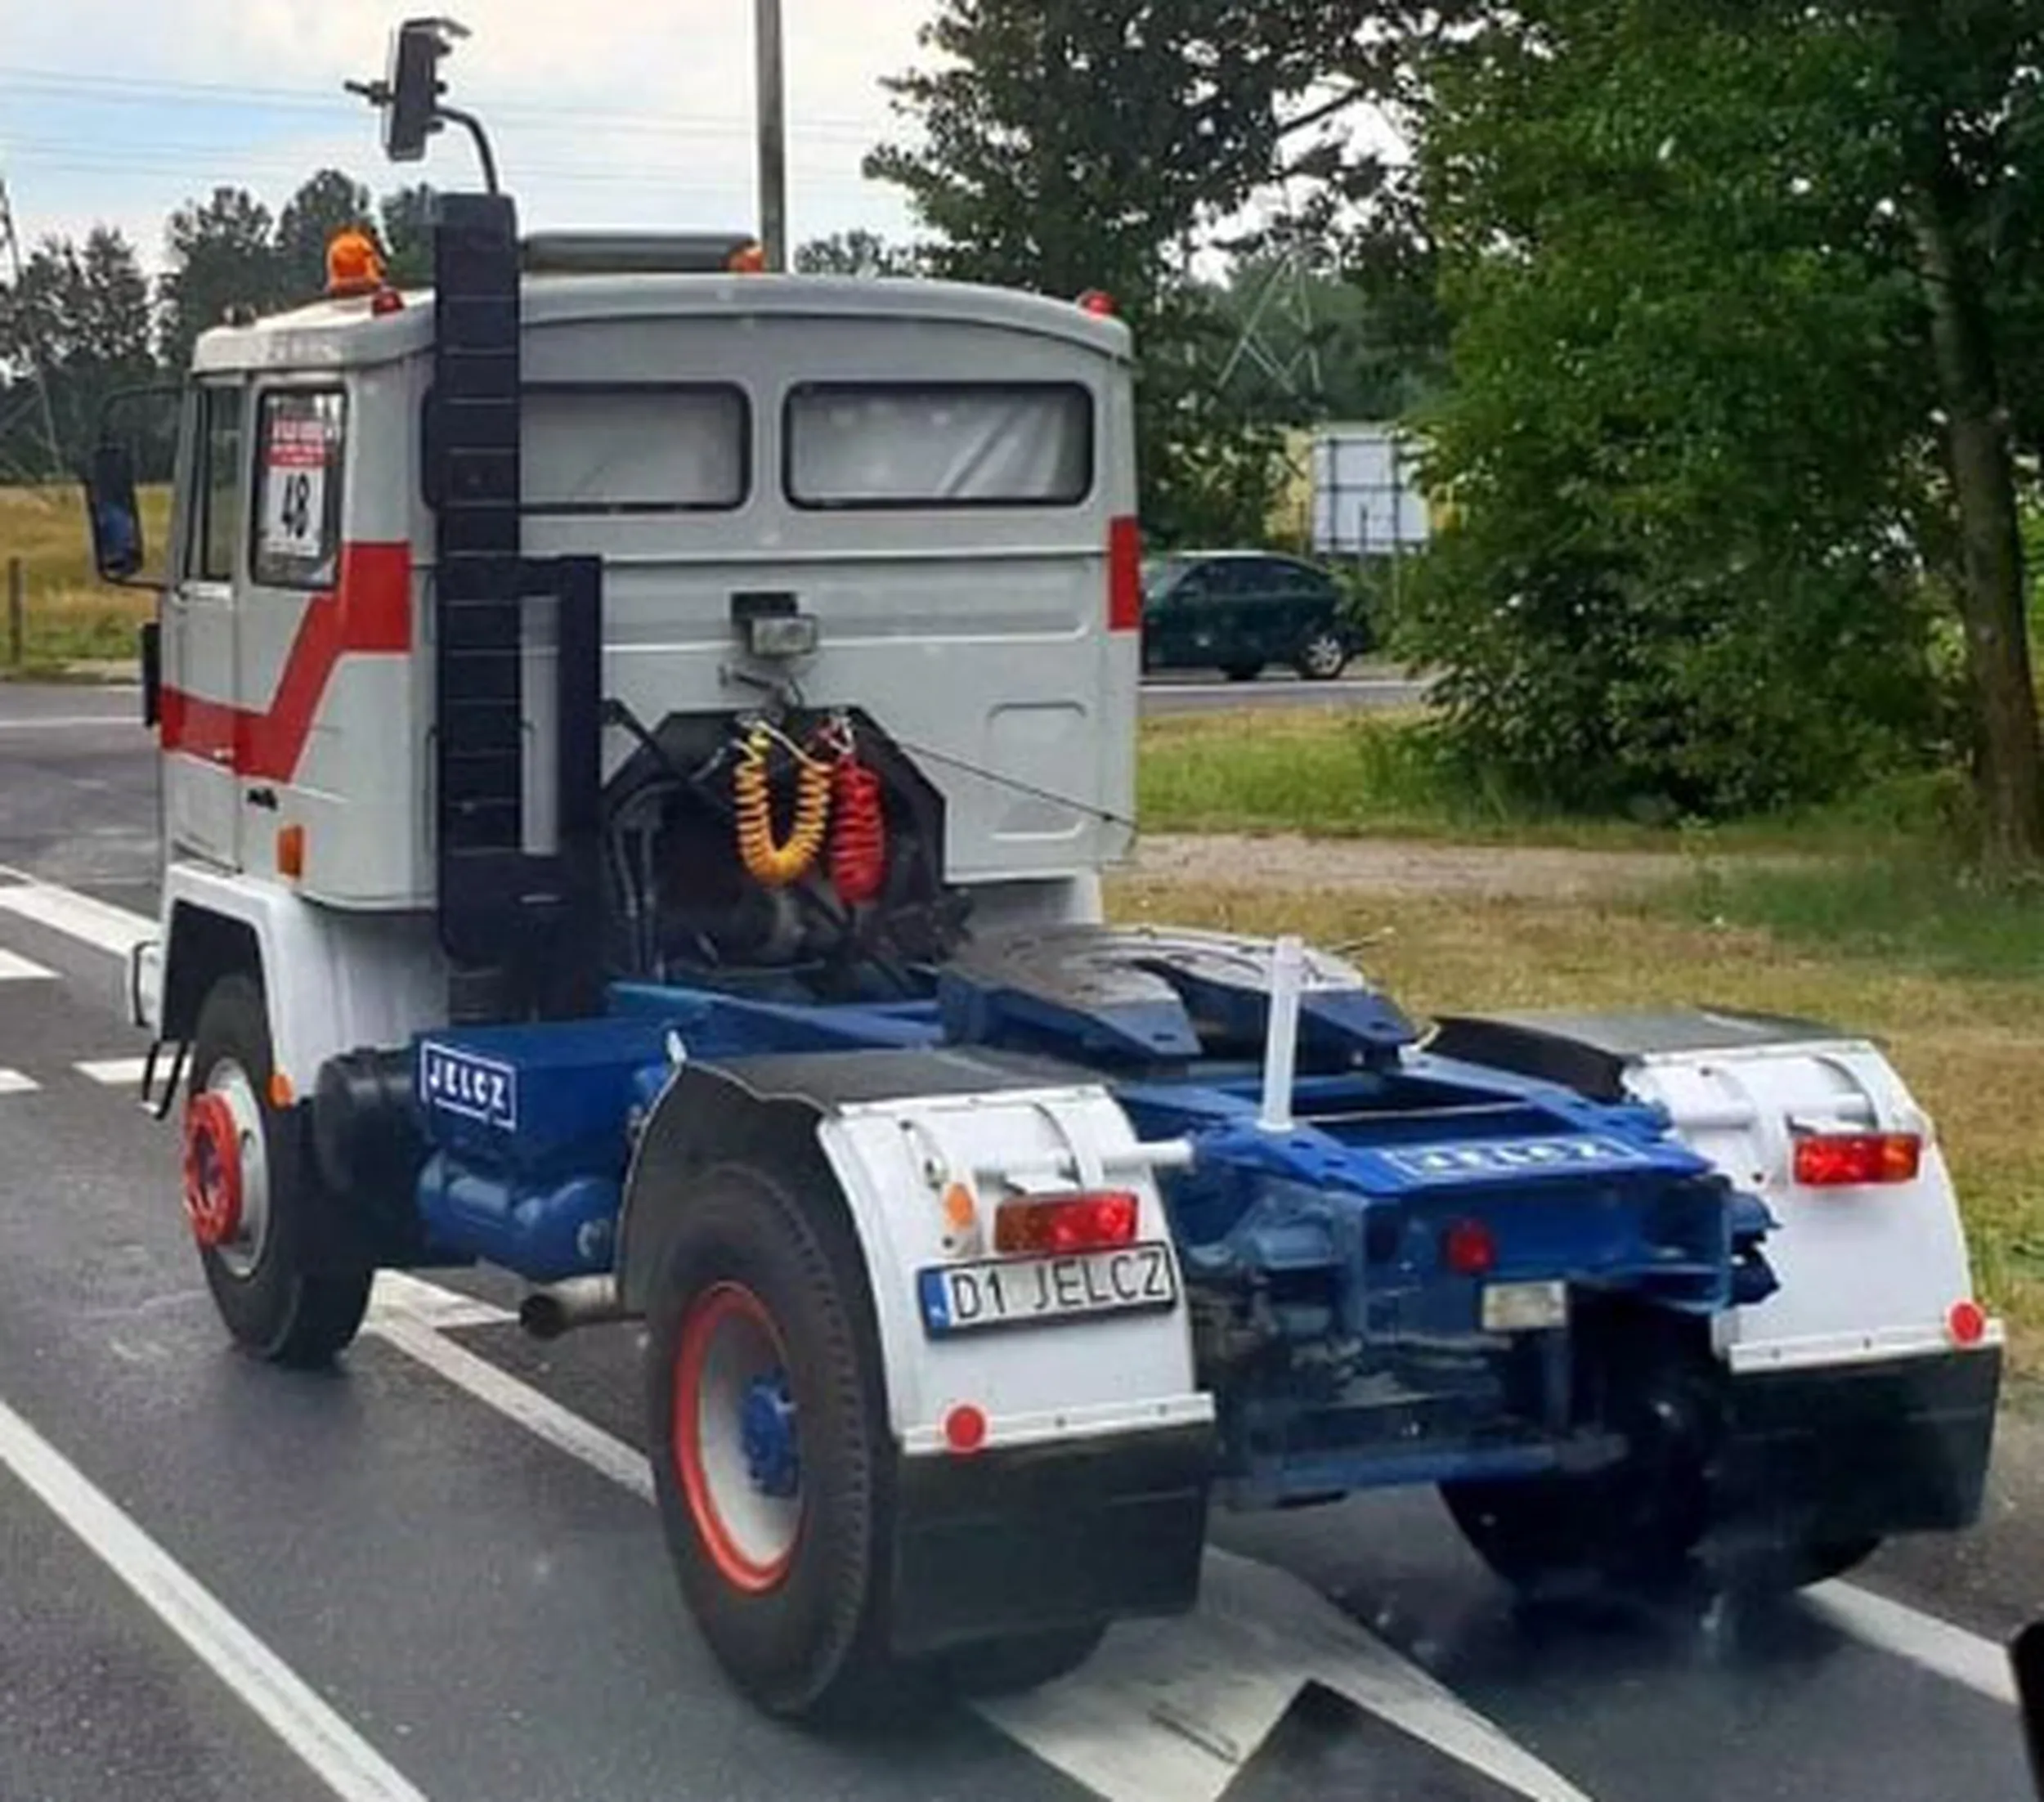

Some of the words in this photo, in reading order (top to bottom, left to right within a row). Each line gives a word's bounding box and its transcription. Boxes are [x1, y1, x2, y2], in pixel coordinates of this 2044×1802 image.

[281, 472, 310, 539] 48
[429, 1056, 506, 1112] JELCZ
[951, 1269, 1006, 1320] D1
[1033, 1250, 1166, 1310] JELCZ
